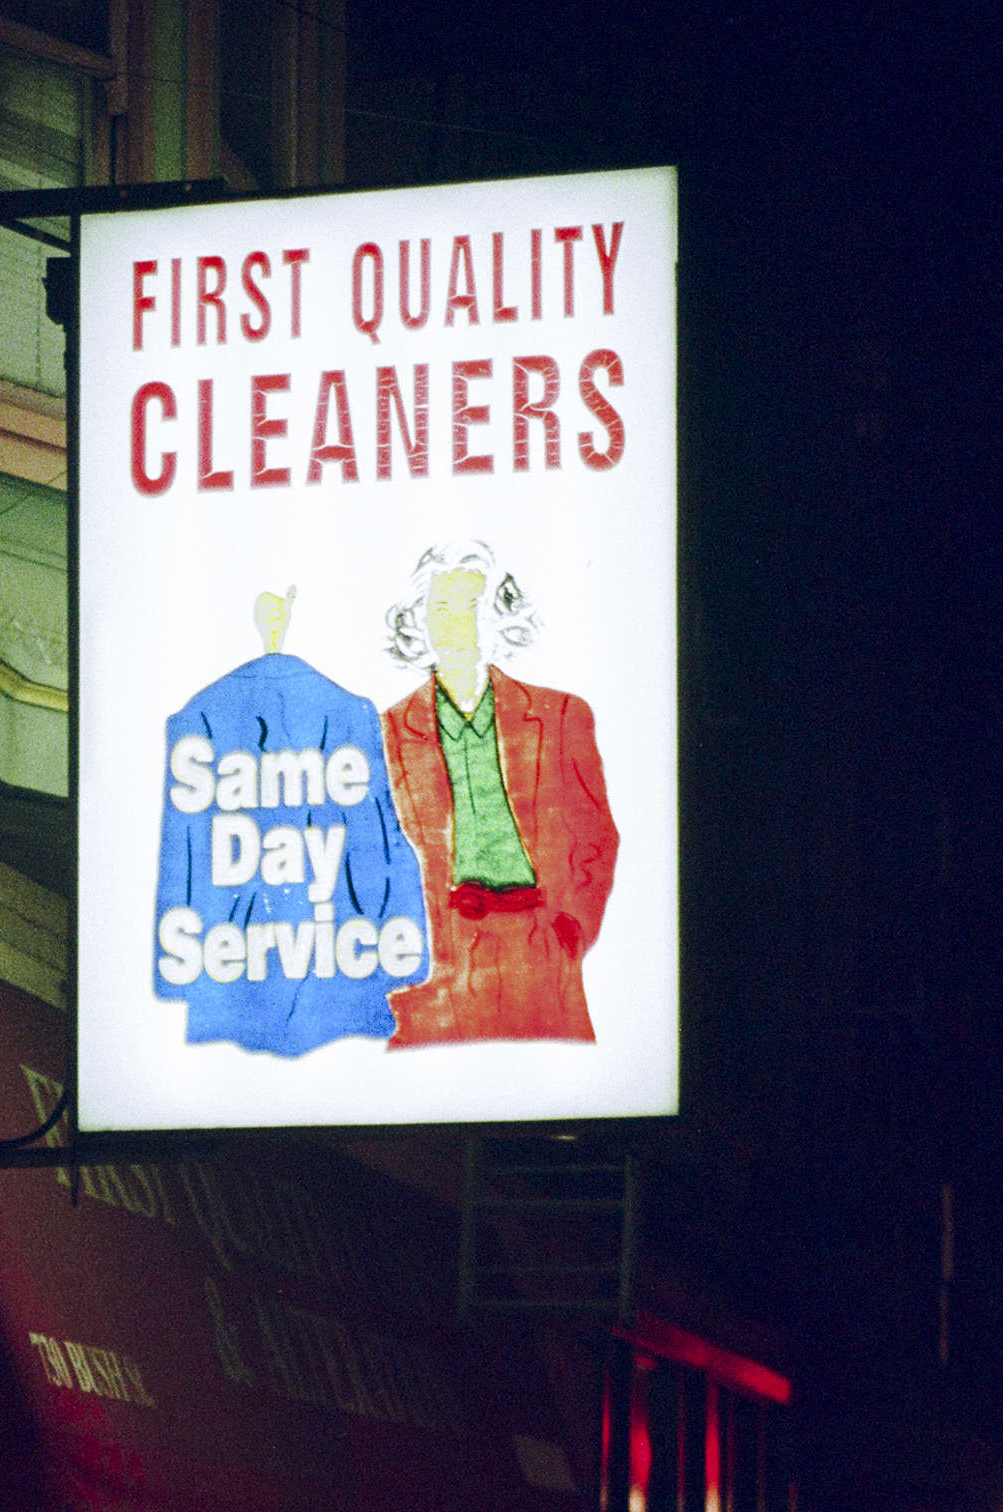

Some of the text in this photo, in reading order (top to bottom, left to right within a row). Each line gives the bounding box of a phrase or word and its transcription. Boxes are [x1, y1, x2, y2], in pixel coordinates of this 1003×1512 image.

[132, 221, 625, 352] FIRST QUALITY
[130, 348, 626, 498] CLEANERS
[170, 734, 370, 813] Same
[210, 814, 346, 903] Day
[158, 902, 423, 985] Service
